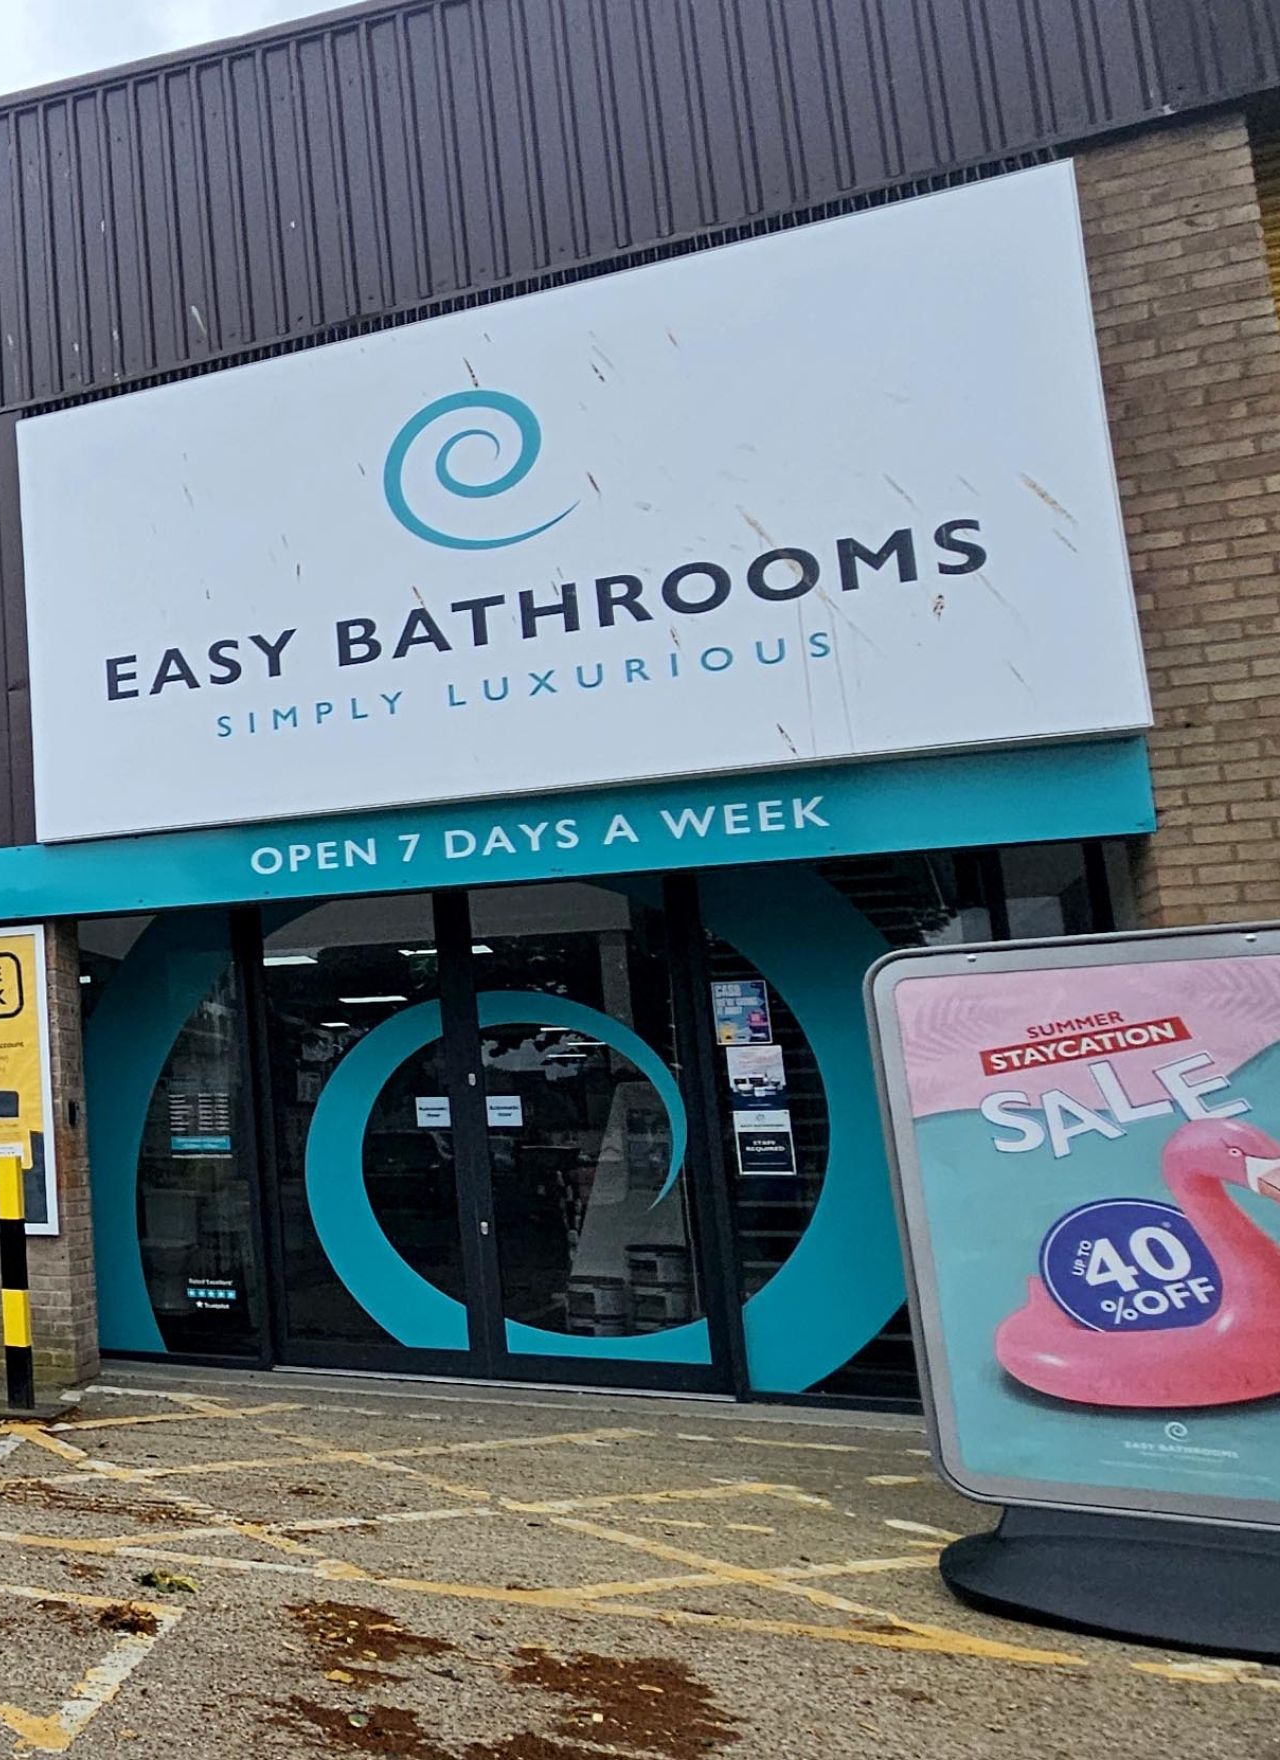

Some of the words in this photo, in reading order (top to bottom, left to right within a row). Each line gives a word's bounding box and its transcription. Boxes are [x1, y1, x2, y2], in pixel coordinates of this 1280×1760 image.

[106, 628, 297, 701] EASY
[336, 518, 987, 667] BATHROOMS
[216, 691, 403, 737] SIMPLY
[447, 632, 831, 707] LUXURIOUS
[250, 838, 377, 875] OPEN
[398, 834, 421, 862] 7
[444, 818, 580, 859] DAYS
[603, 814, 640, 844] A
[660, 795, 830, 839] WEEK
[990, 1021, 1177, 1071] STAYCATION
[1027, 1010, 1124, 1039] SUMMER
[980, 1050, 1254, 1160] SALE
[1072, 1259, 1087, 1276] UP
[1078, 1240, 1093, 1258] TO
[1085, 1226, 1192, 1292] 40
[1100, 1276, 1216, 1325] %OFF
